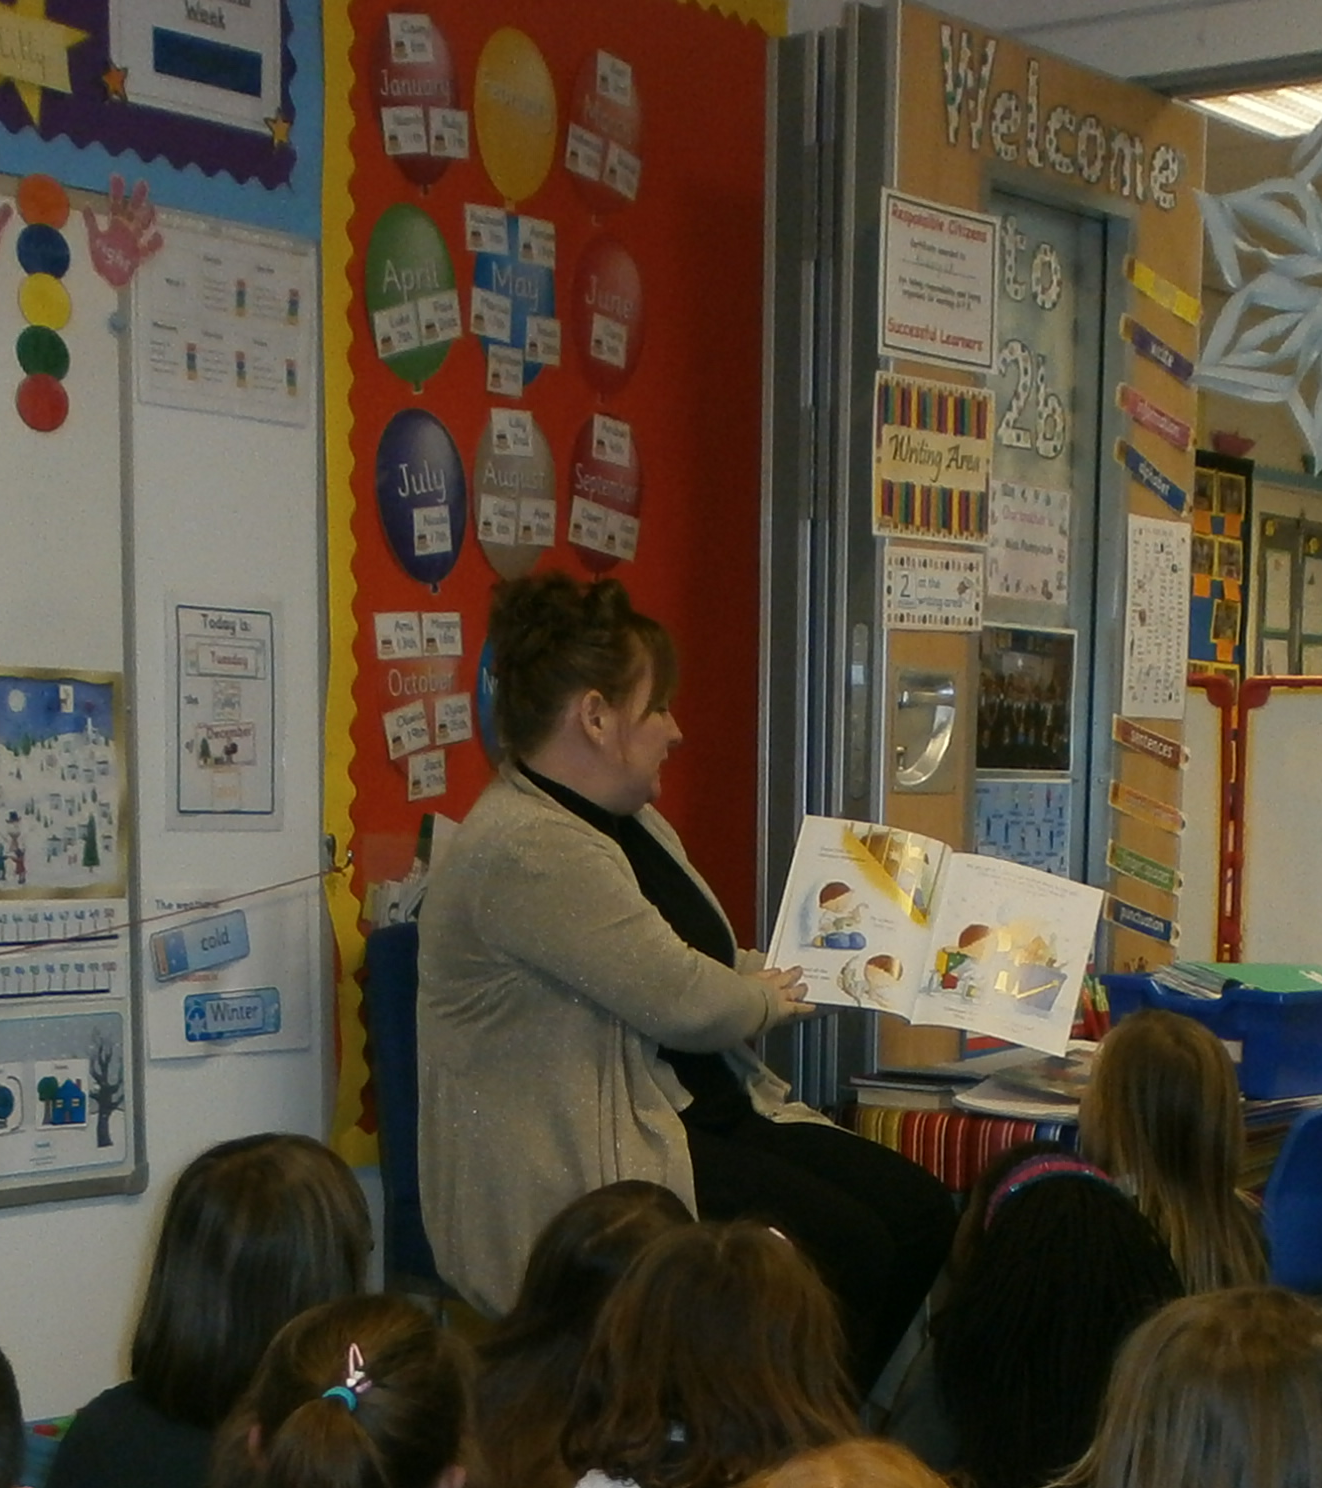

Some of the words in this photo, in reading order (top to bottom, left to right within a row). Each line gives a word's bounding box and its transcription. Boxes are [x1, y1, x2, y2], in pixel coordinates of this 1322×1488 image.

[381, 69, 451, 106] January
[940, 24, 1180, 209] Welcome
[383, 258, 441, 303] April
[1003, 215, 1062, 310] to
[492, 261, 539, 312] May
[585, 275, 636, 318] June
[889, 434, 942, 482] Writing
[946, 444, 981, 473] Area
[398, 460, 447, 502] July
[483, 462, 548, 498] August
[575, 462, 639, 503] September
[900, 573, 911, 599] 2
[202, 613, 237, 636] Today
[210, 651, 248, 670] Tuesday
[388, 667, 455, 697] October
[206, 726, 252, 740] December
[1130, 729, 1174, 759] sentences
[200, 926, 231, 952] cold
[210, 1001, 259, 1022] Winter
